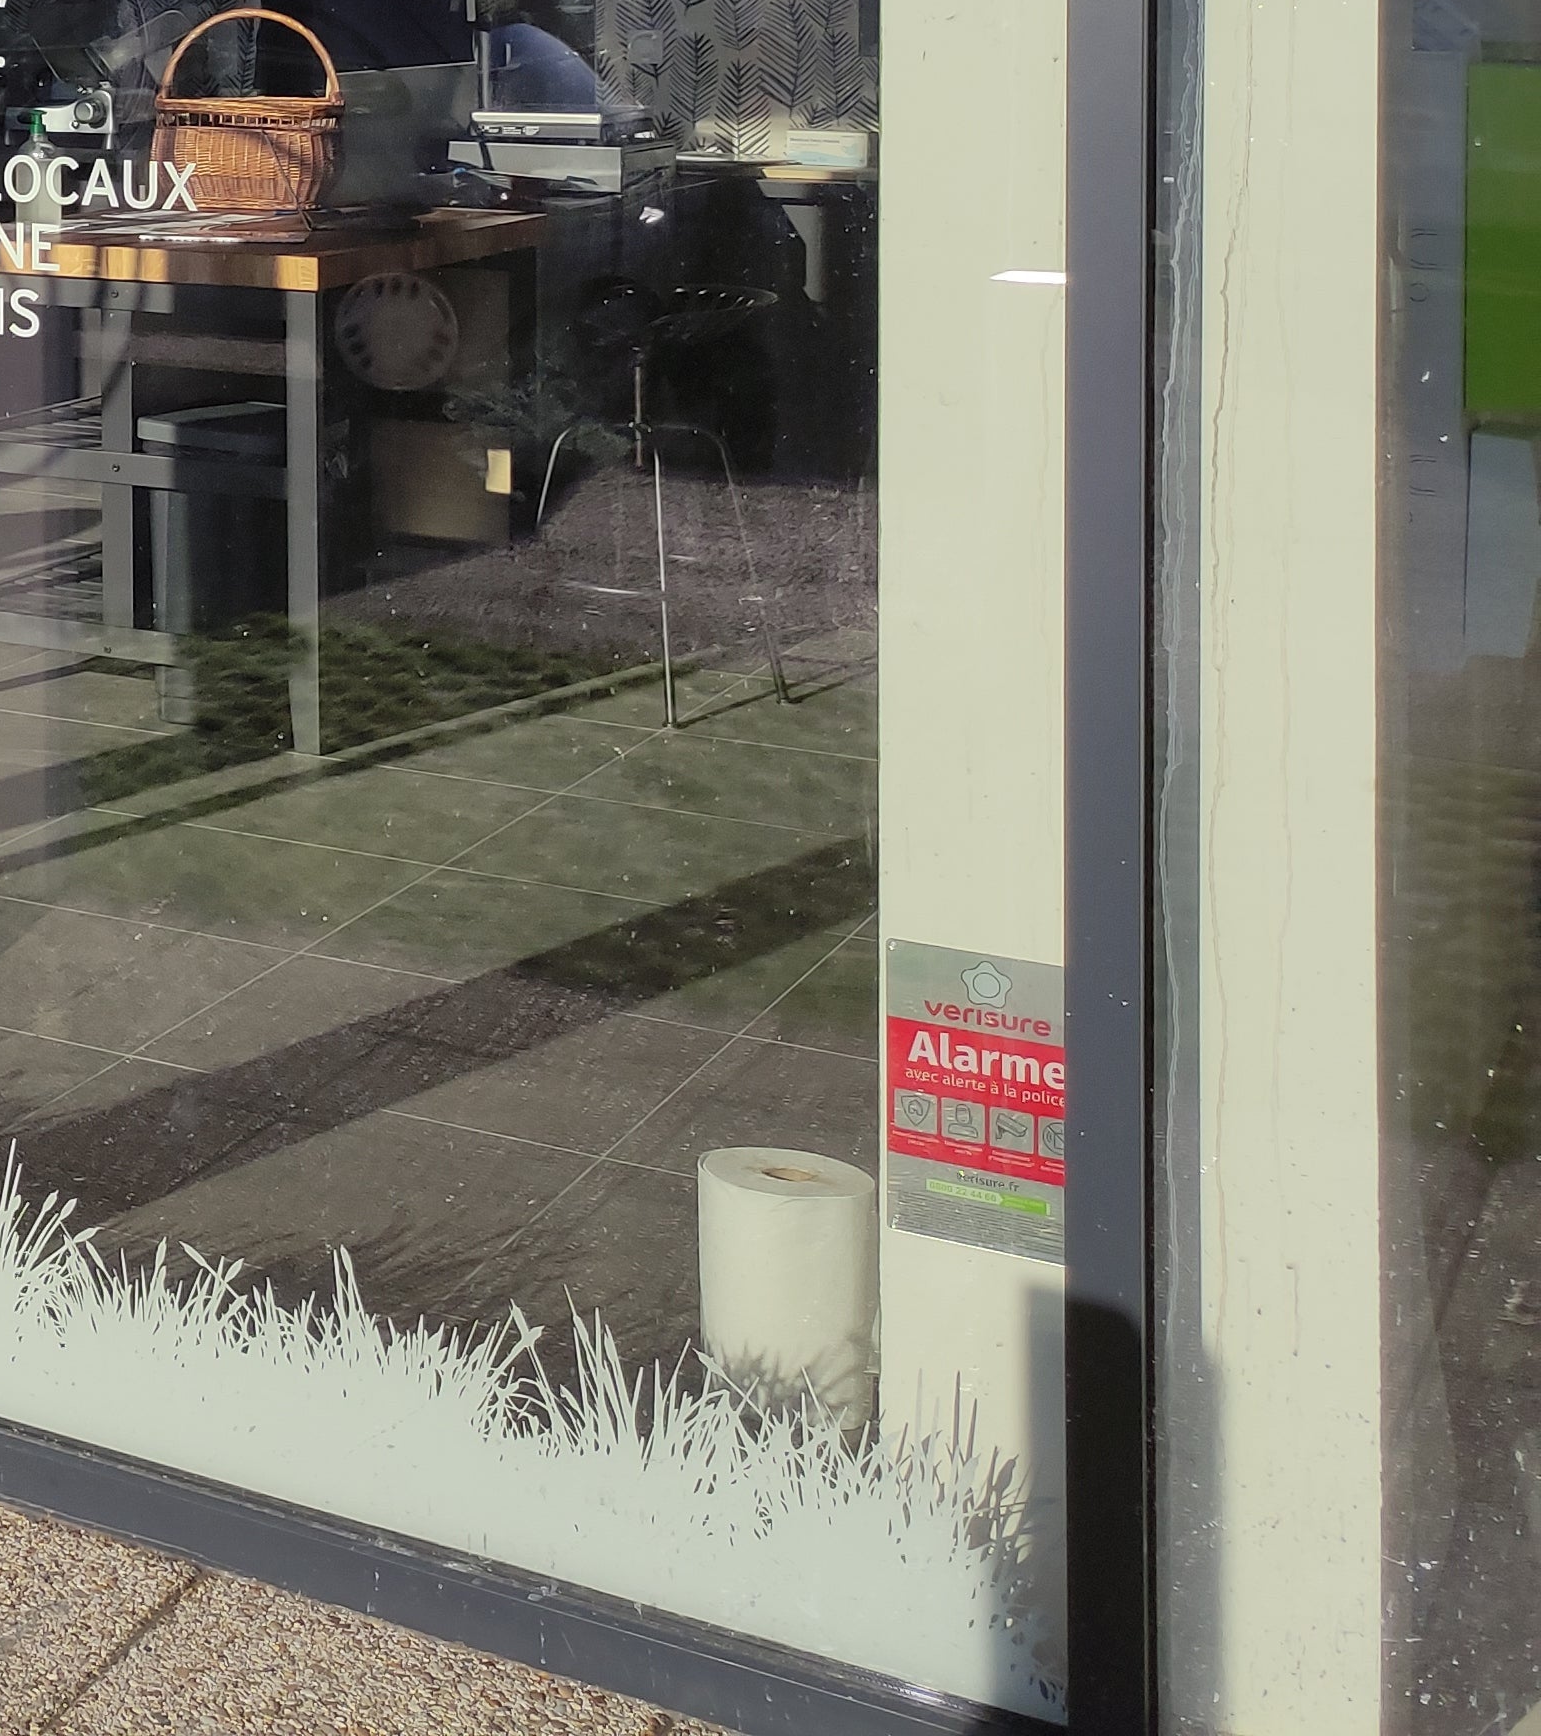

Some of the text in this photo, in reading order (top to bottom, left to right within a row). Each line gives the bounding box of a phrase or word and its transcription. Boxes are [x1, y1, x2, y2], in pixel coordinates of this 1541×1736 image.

[924, 1000, 1051, 1036] verisure
[908, 1031, 1065, 1090] Alarme
[905, 1068, 939, 1082] avec
[942, 1074, 986, 1092] alerte
[990, 1081, 999, 1095] à
[1003, 1084, 1017, 1098] la
